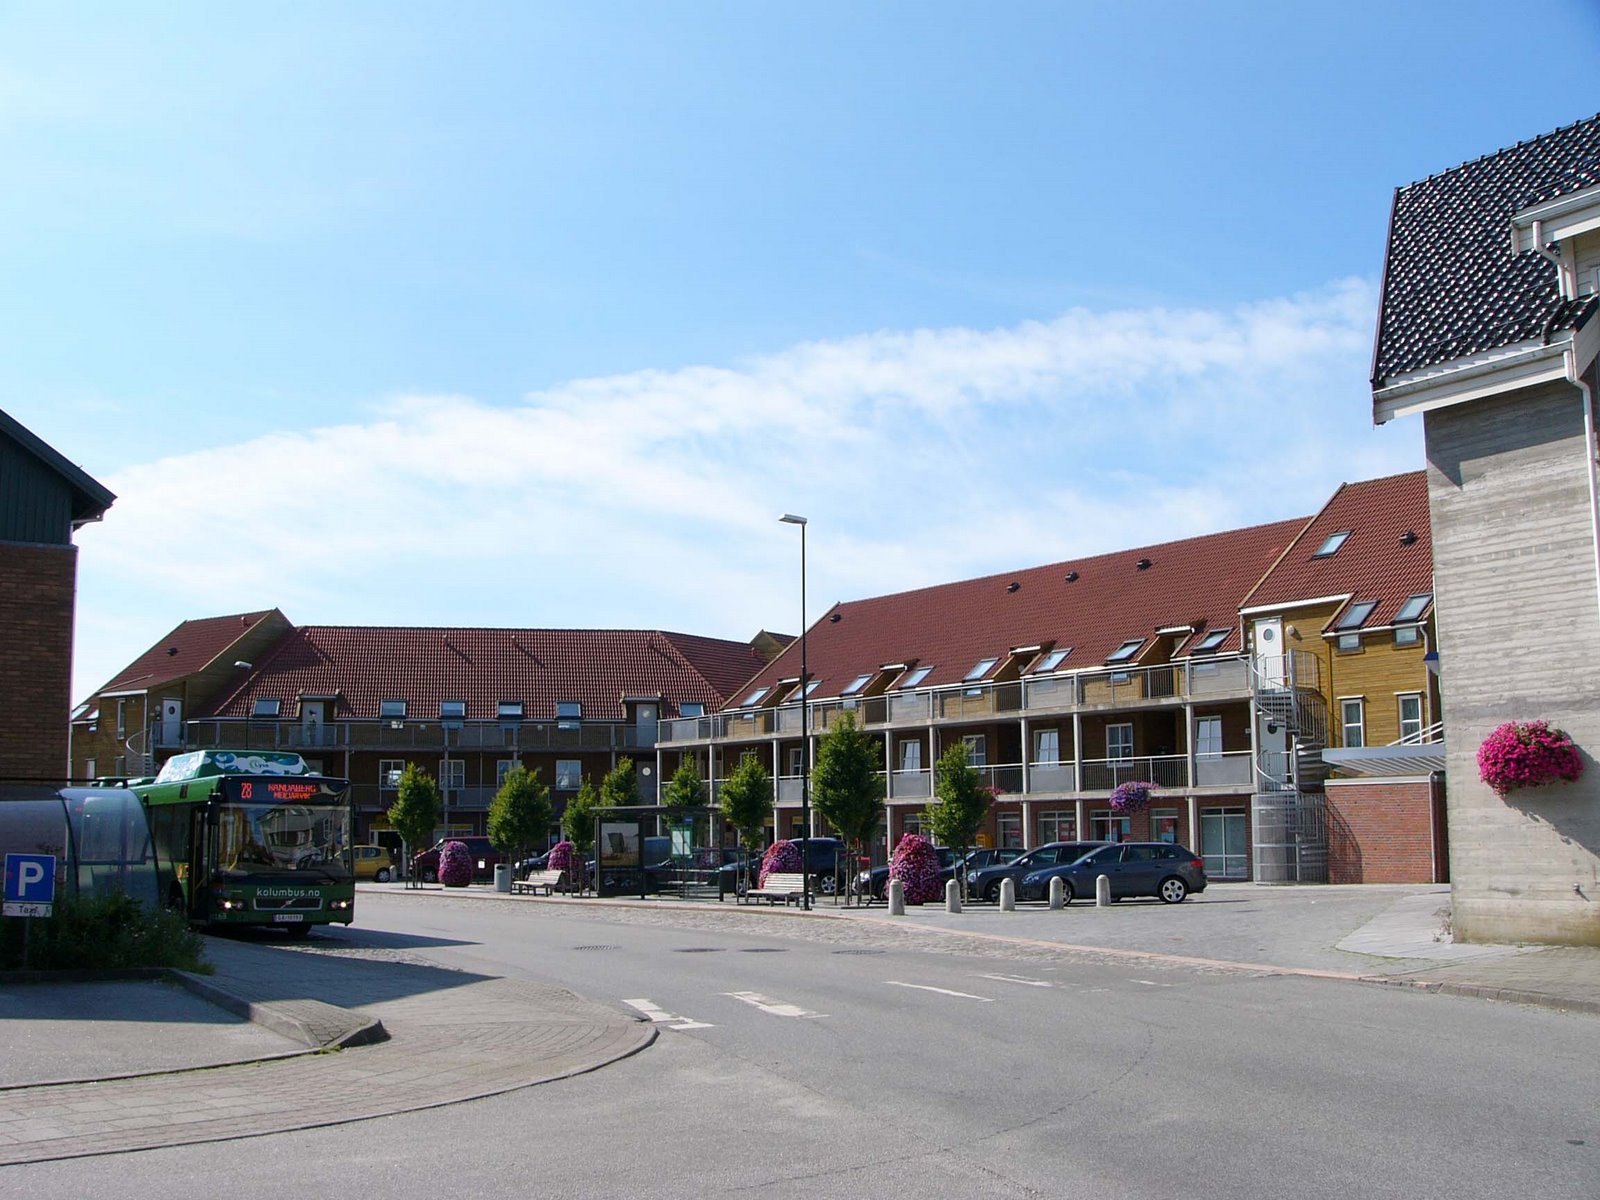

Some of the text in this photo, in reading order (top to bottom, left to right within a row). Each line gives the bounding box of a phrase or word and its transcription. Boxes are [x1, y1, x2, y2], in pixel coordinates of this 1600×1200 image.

[241, 782, 252, 799] 28
[18, 861, 44, 897] P
[256, 887, 320, 898] kolumbus.no
[18, 905, 38, 914] Taxi
